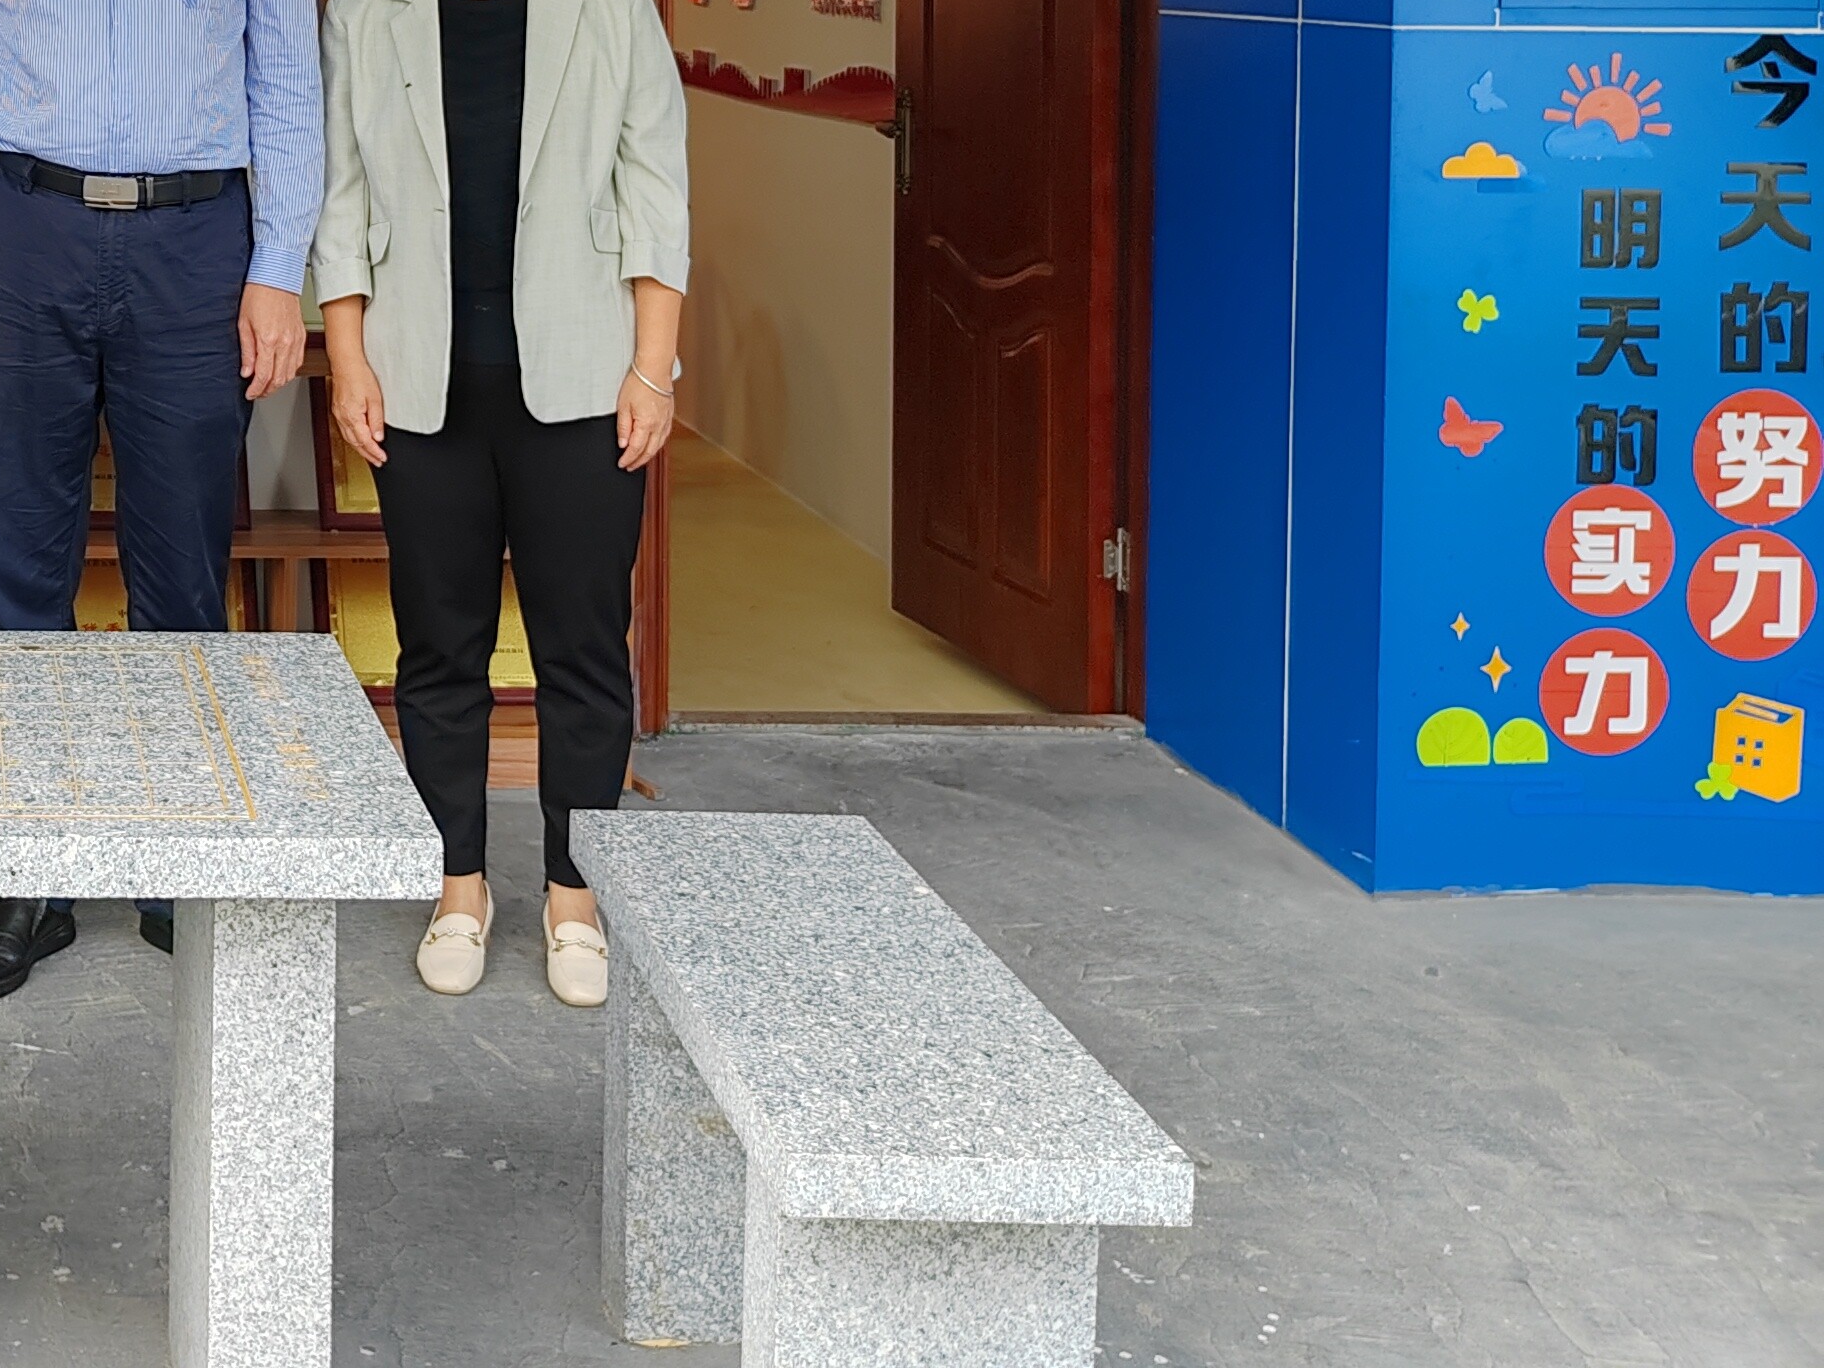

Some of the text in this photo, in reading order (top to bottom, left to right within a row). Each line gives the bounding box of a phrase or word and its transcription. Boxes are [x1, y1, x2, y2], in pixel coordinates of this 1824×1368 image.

[1563, 188, 1663, 737] 明天的实力
[1710, 33, 1819, 642] 今天的努力
